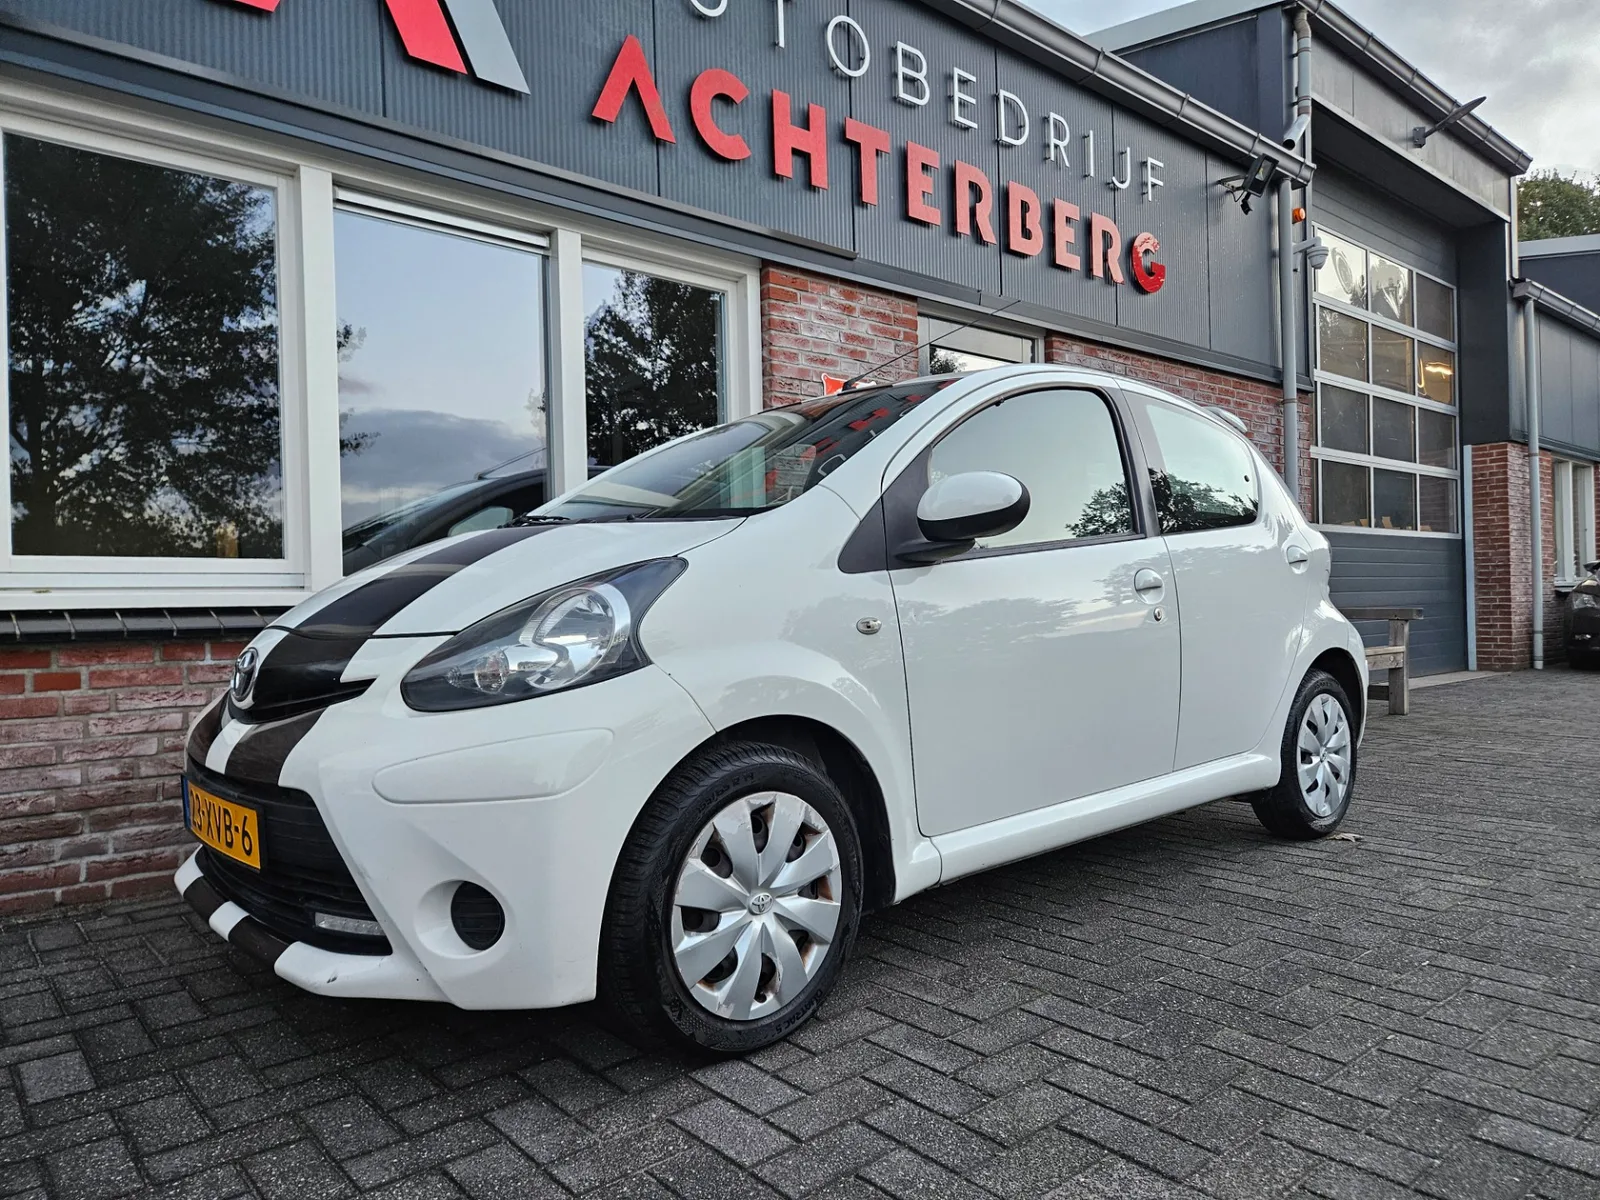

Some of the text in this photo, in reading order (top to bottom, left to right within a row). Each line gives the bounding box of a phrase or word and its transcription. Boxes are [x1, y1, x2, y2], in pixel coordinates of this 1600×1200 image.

[591, 34, 1166, 293] ACHTERBERG
[690, 0, 1165, 201] OBEDRIJF
[190, 788, 253, 856] 23-XVB-6
